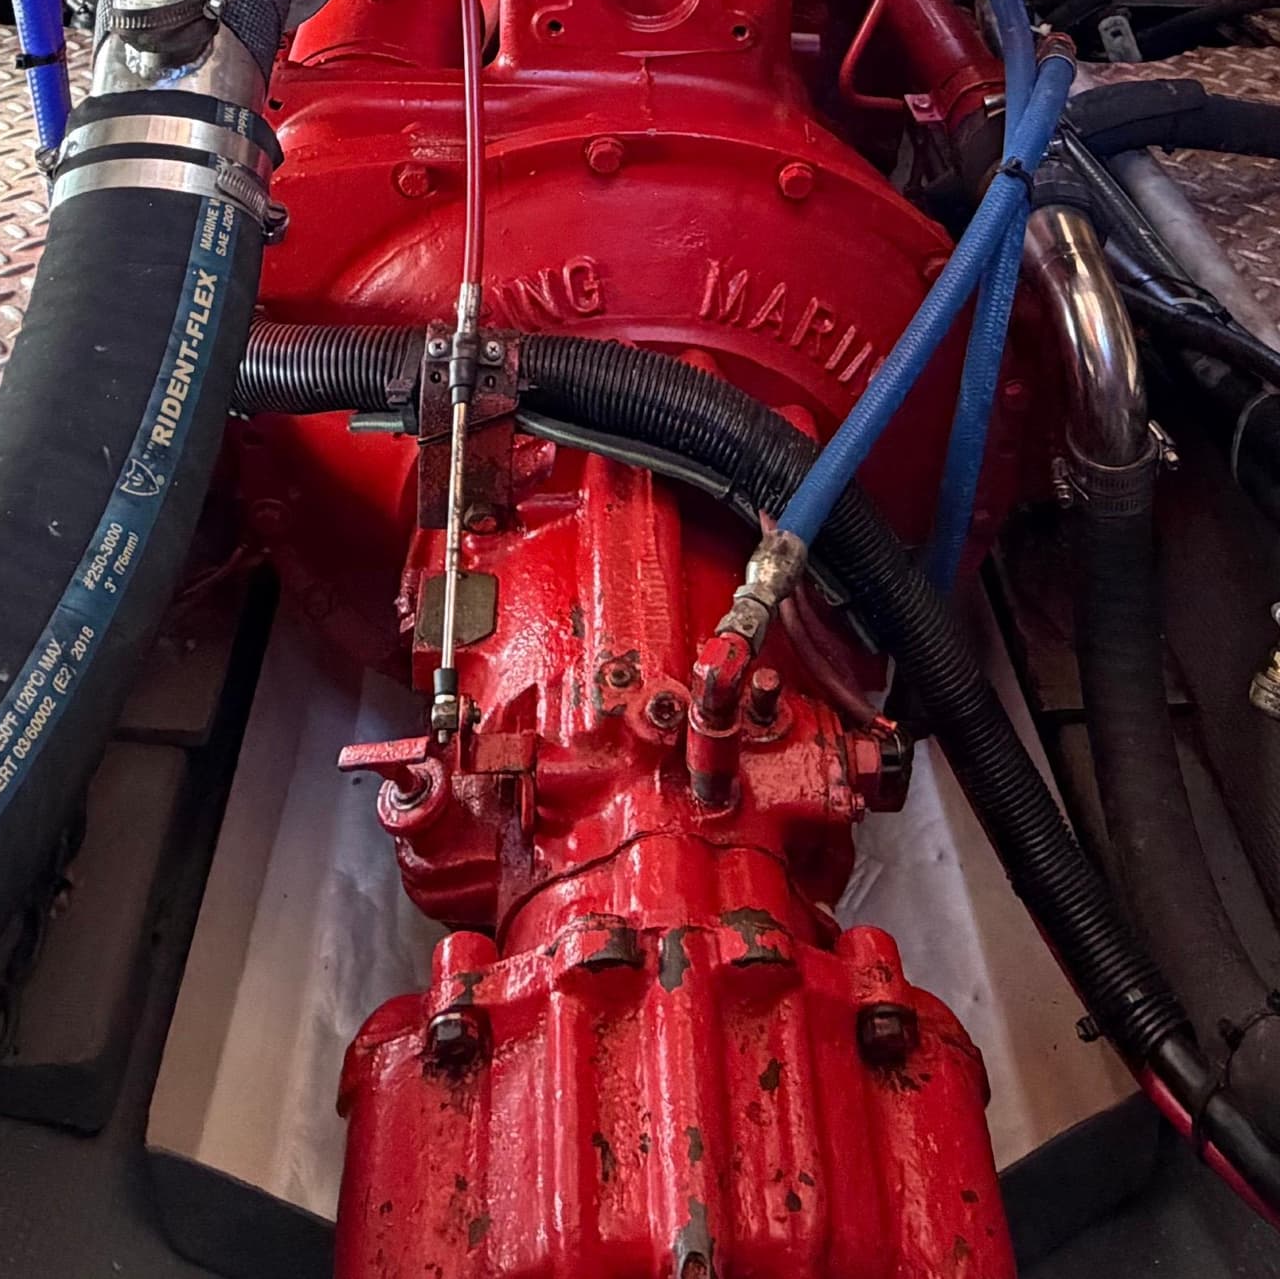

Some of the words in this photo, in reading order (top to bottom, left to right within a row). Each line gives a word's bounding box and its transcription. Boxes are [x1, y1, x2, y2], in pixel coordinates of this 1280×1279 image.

[199, 209, 219, 251] MARINE
[216, 229, 230, 256] SAE
[225, 204, 236, 231] J200
[82, 523, 123, 591] #250-3000
[113, 531, 139, 575] (76mm)
[12, 696, 57, 759] 03/60002
[52, 663, 77, 695] (E2)
[70, 625, 95, 661] 2018
[14, 669, 47, 714] (120°C)
